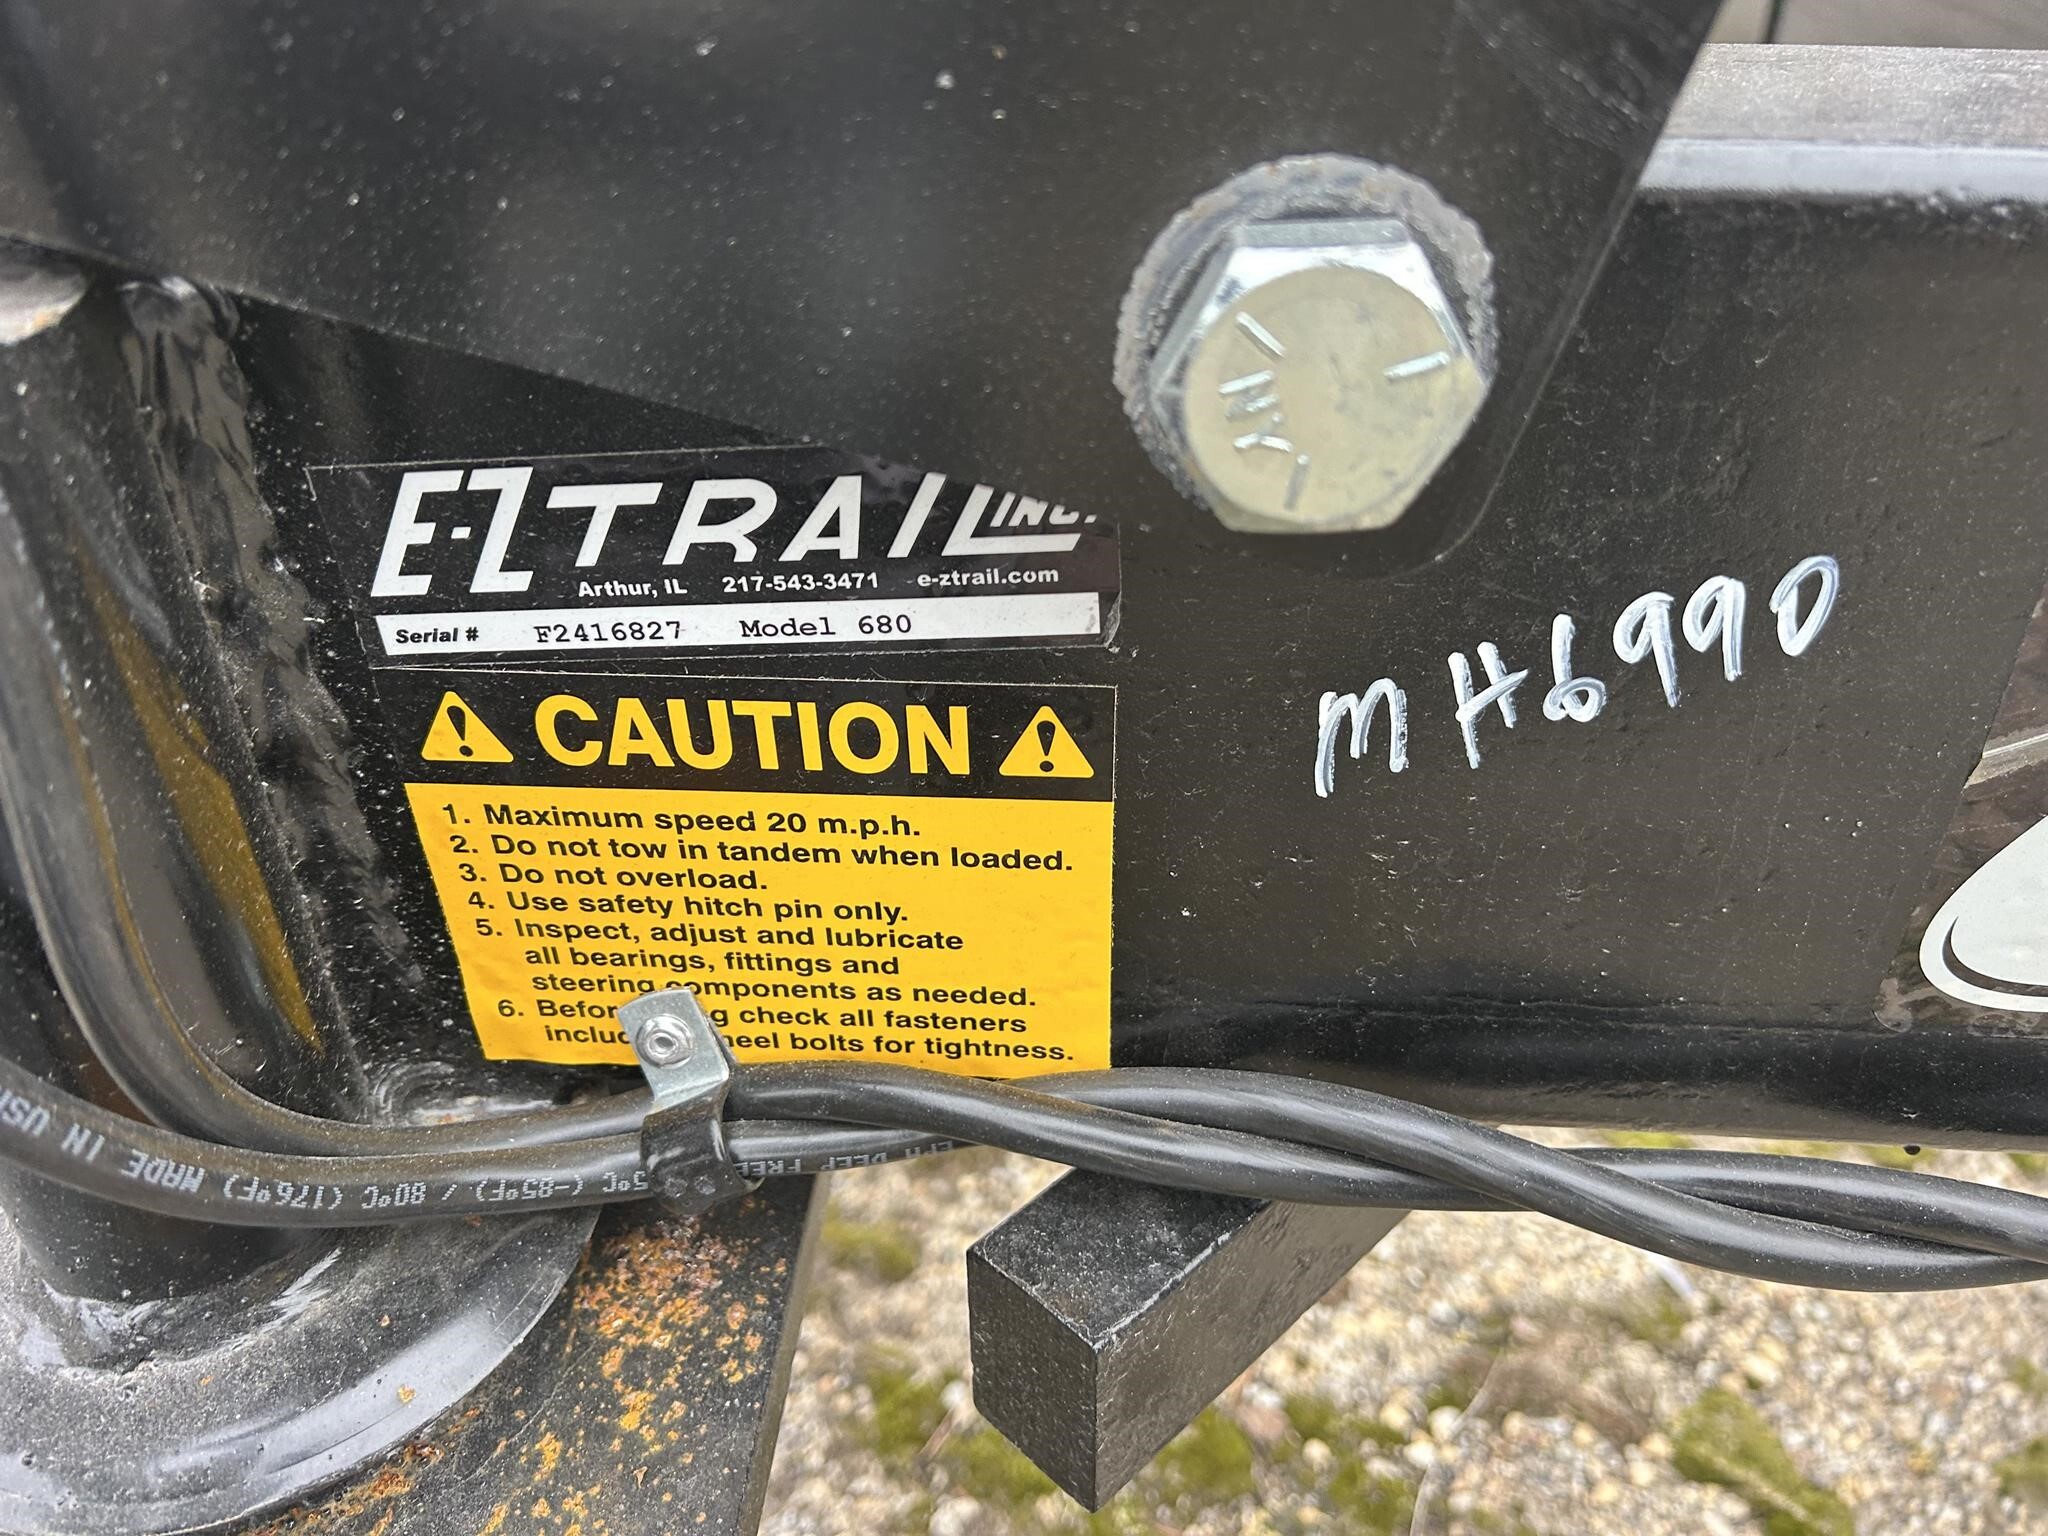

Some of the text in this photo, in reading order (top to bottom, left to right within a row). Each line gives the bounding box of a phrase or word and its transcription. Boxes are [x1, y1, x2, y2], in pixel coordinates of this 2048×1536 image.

[578, 567, 1059, 598] Arthur, IL 217-543-3471 e-ztrail.com
[395, 614, 912, 644] Serial # F2416827 Model 680
[534, 694, 971, 775] CAUTION
[442, 803, 921, 840] 1. Maximum speed 20 m.p.h.
[449, 834, 1073, 871] 2. Do not tow in tandem when loaded.
[459, 863, 768, 890] 3. Do not overload.
[467, 890, 908, 925] 4. Use safety hitch pin only.
[475, 918, 964, 950] 5. Inspect, adjust and lubricate
[524, 946, 900, 977] all bearings, fittings and
[866, 985, 902, 1002] as
[912, 986, 1037, 1007] needed.
[497, 999, 524, 1017] 6.
[537, 999, 619, 1019] Befor
[739, 1005, 831, 1026] check
[839, 1008, 874, 1027] all
[885, 1010, 1027, 1033] fasteners
[545, 1024, 631, 1045] inclu
[789, 1032, 865, 1053] bolts
[873, 1035, 916, 1054] for
[924, 1037, 1075, 1061] tightness.
[61, 1123, 106, 1162] IN
[121, 1148, 206, 1193] MADE
[734, 1158, 802, 1177] FREE
